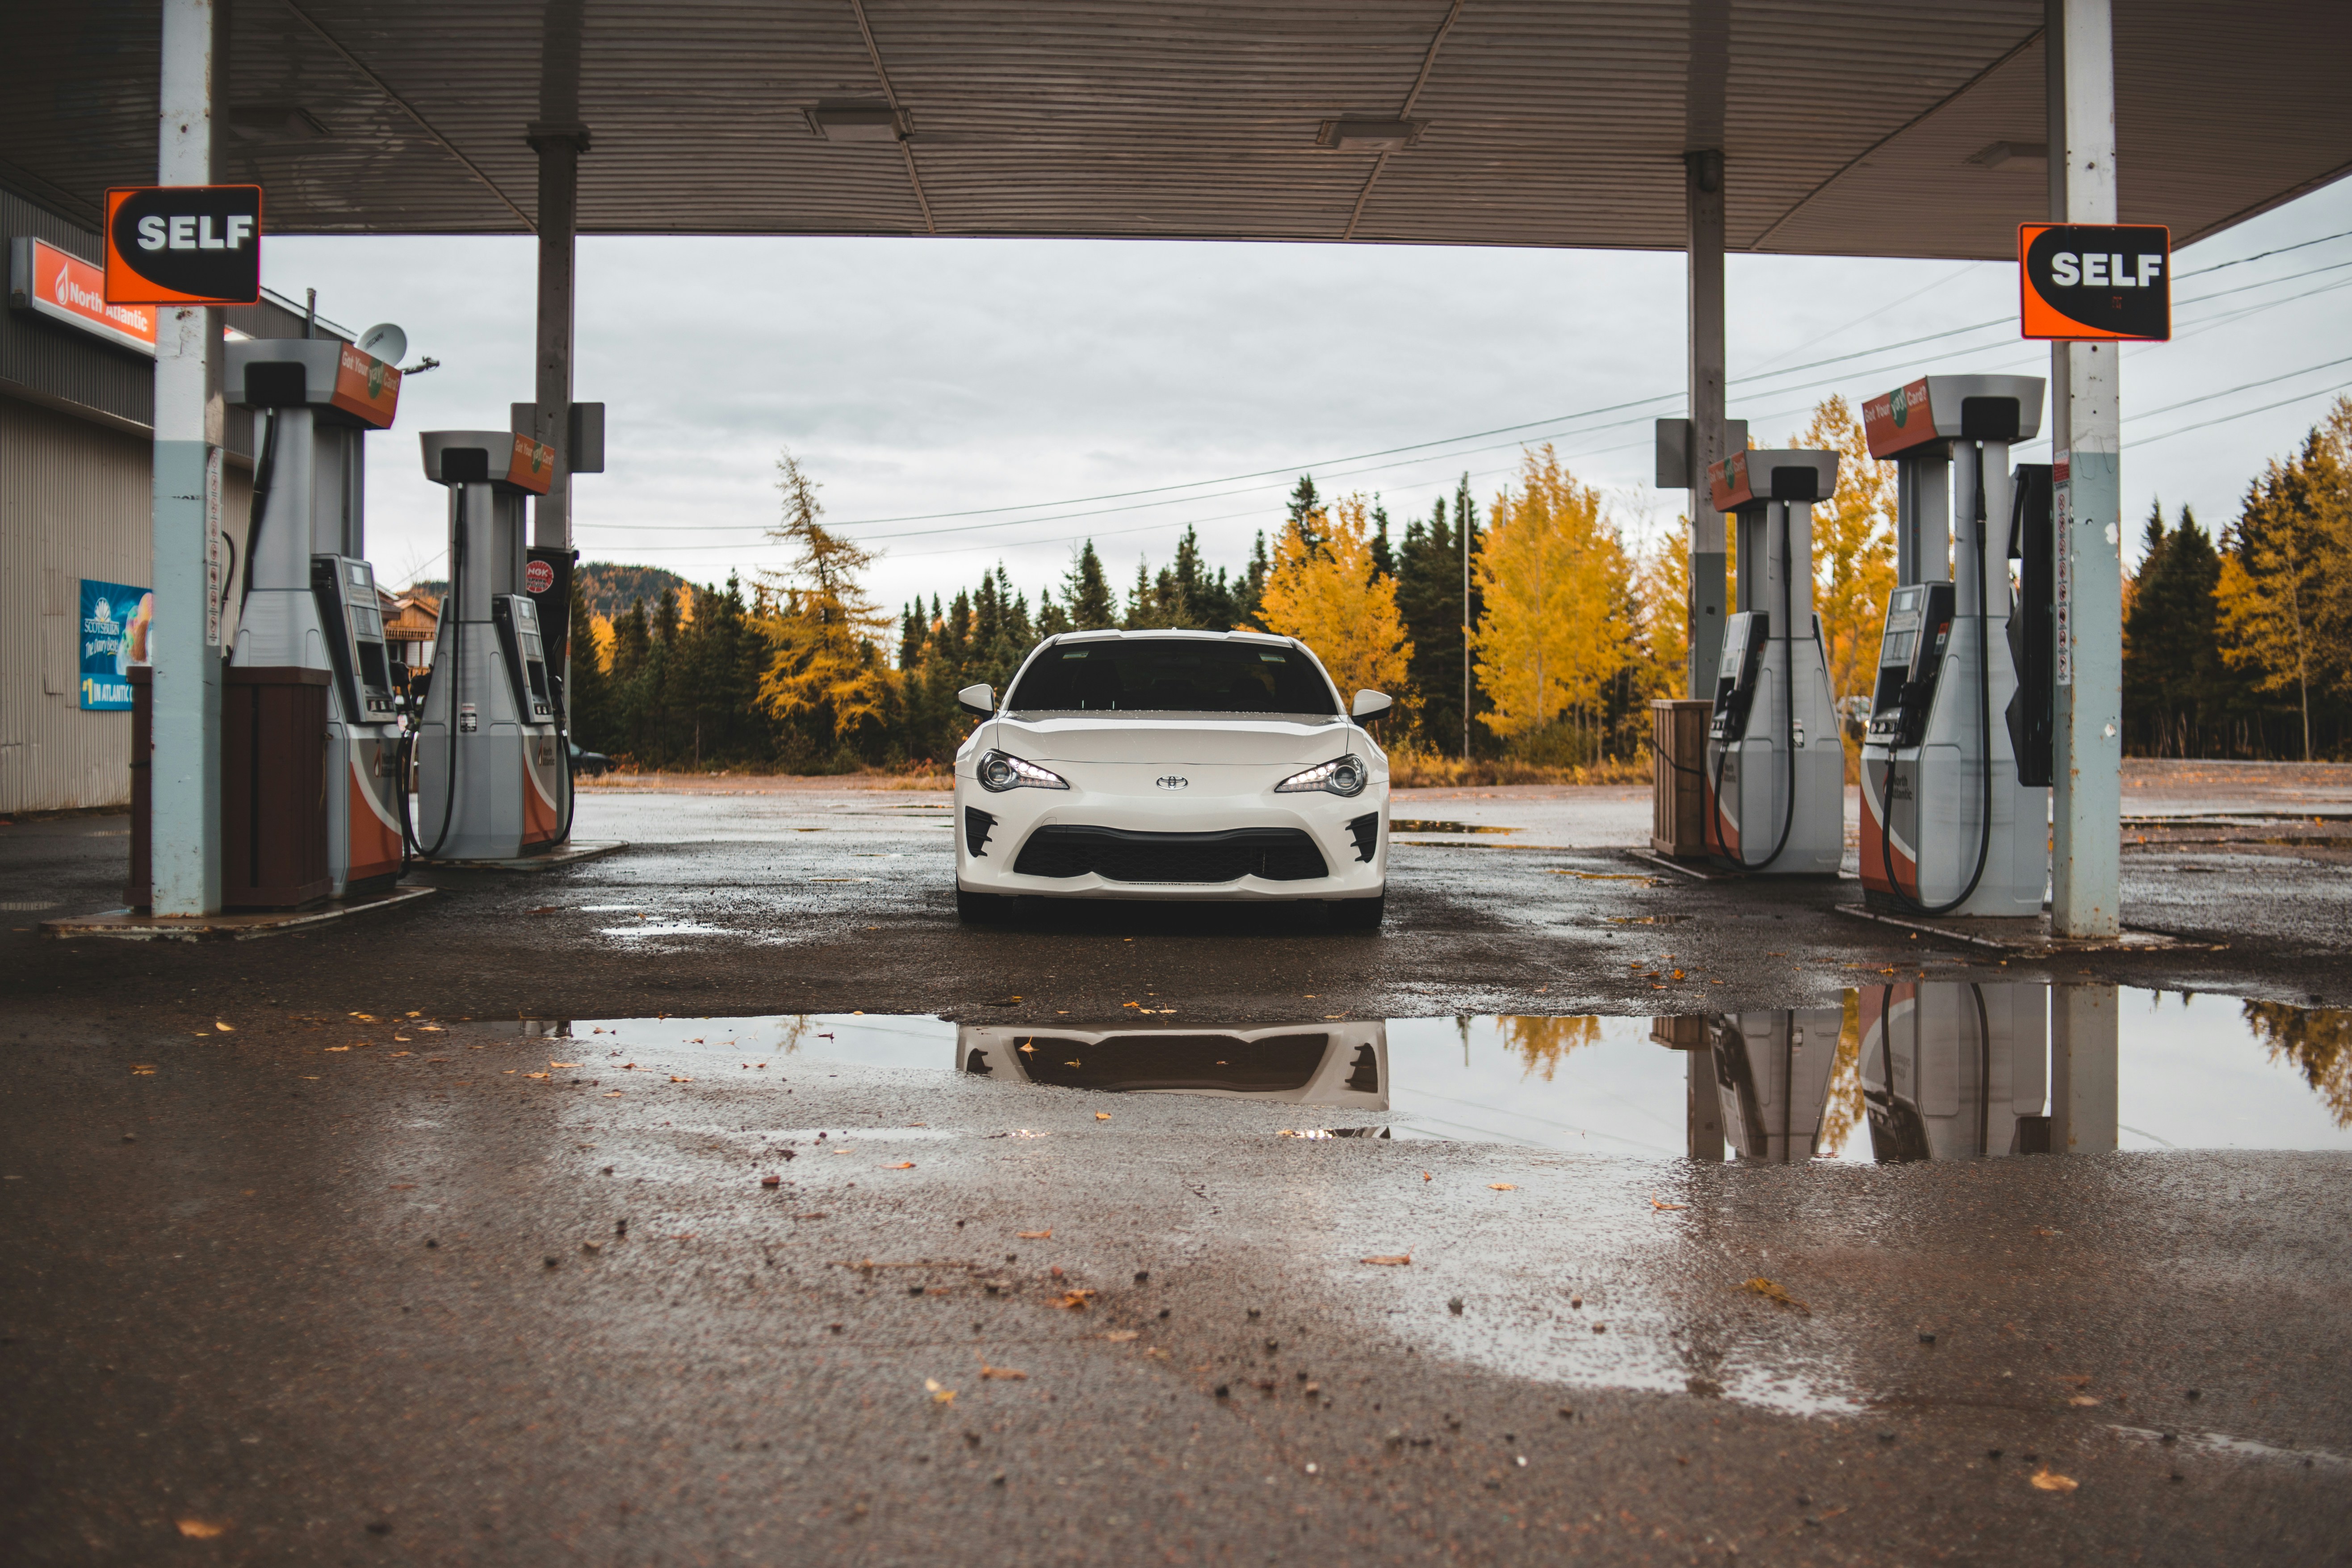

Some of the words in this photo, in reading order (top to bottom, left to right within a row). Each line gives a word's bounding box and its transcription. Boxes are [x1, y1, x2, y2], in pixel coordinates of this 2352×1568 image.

[137, 215, 253, 250] SELF
[2051, 252, 2162, 287] SELF
[70, 281, 103, 314] North
[105, 306, 148, 332] Atlantic
[342, 351, 354, 370] Got
[355, 356, 369, 377] Your
[1864, 407, 1876, 423] Got
[1875, 403, 1891, 419] Your
[1907, 385, 1927, 407] Card?
[515, 440, 523, 453] Got
[84, 621, 120, 635] SCOTSBURN
[85, 641, 94, 659] The
[93, 637, 107, 654] Dairy
[82, 678, 93, 705] #1
[94, 683, 101, 702] IN
[101, 683, 129, 702] ATLANTIC
